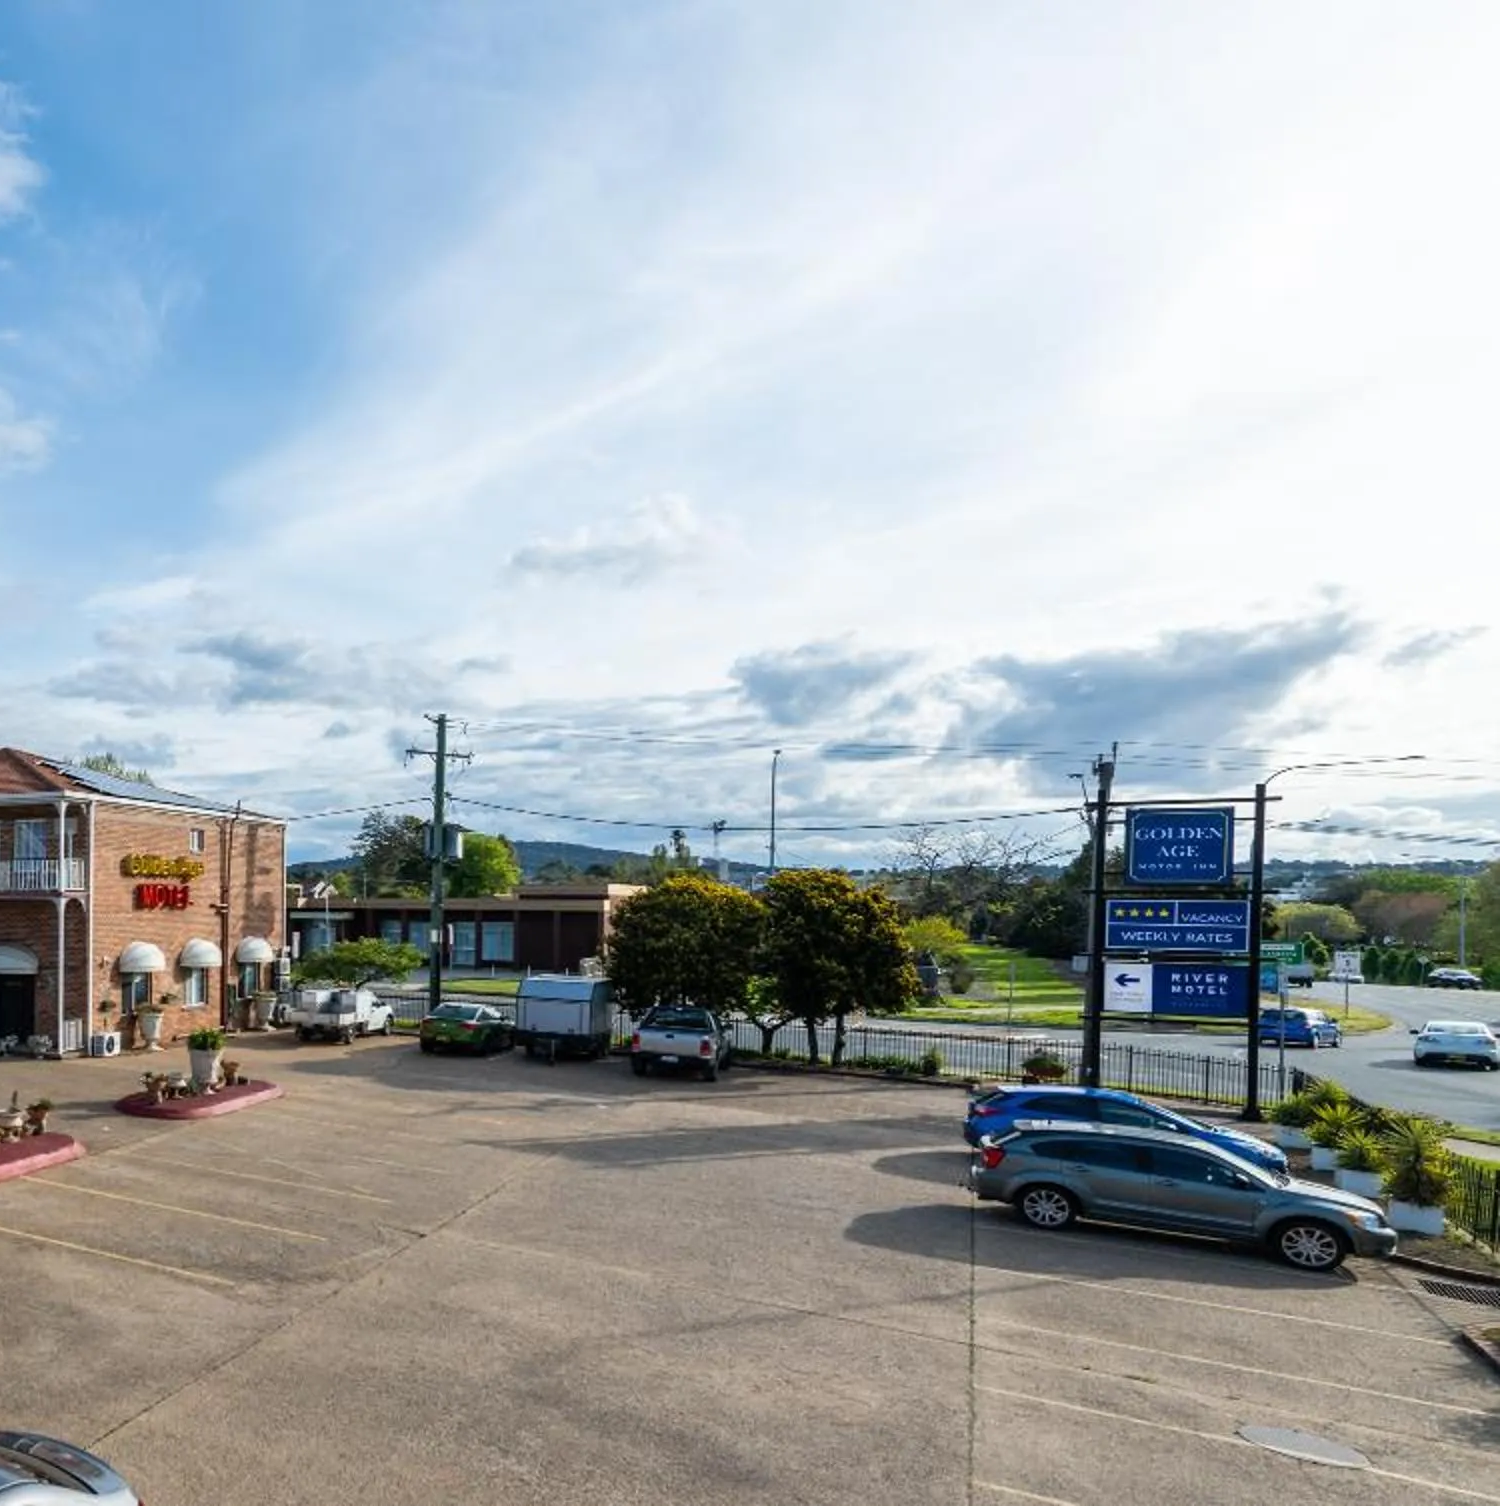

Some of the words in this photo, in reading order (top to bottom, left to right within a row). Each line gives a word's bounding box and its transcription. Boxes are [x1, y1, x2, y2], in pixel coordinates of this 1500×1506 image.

[1135, 827, 1223, 841] GOLDEN
[1156, 845, 1200, 858] AGE
[1181, 913, 1243, 923] VACANCY
[1120, 931, 1180, 942] WEEKLY
[1186, 932, 1233, 943] RATES
[1171, 973, 1229, 984] RIVER
[1171, 985, 1228, 996] MOTEL
